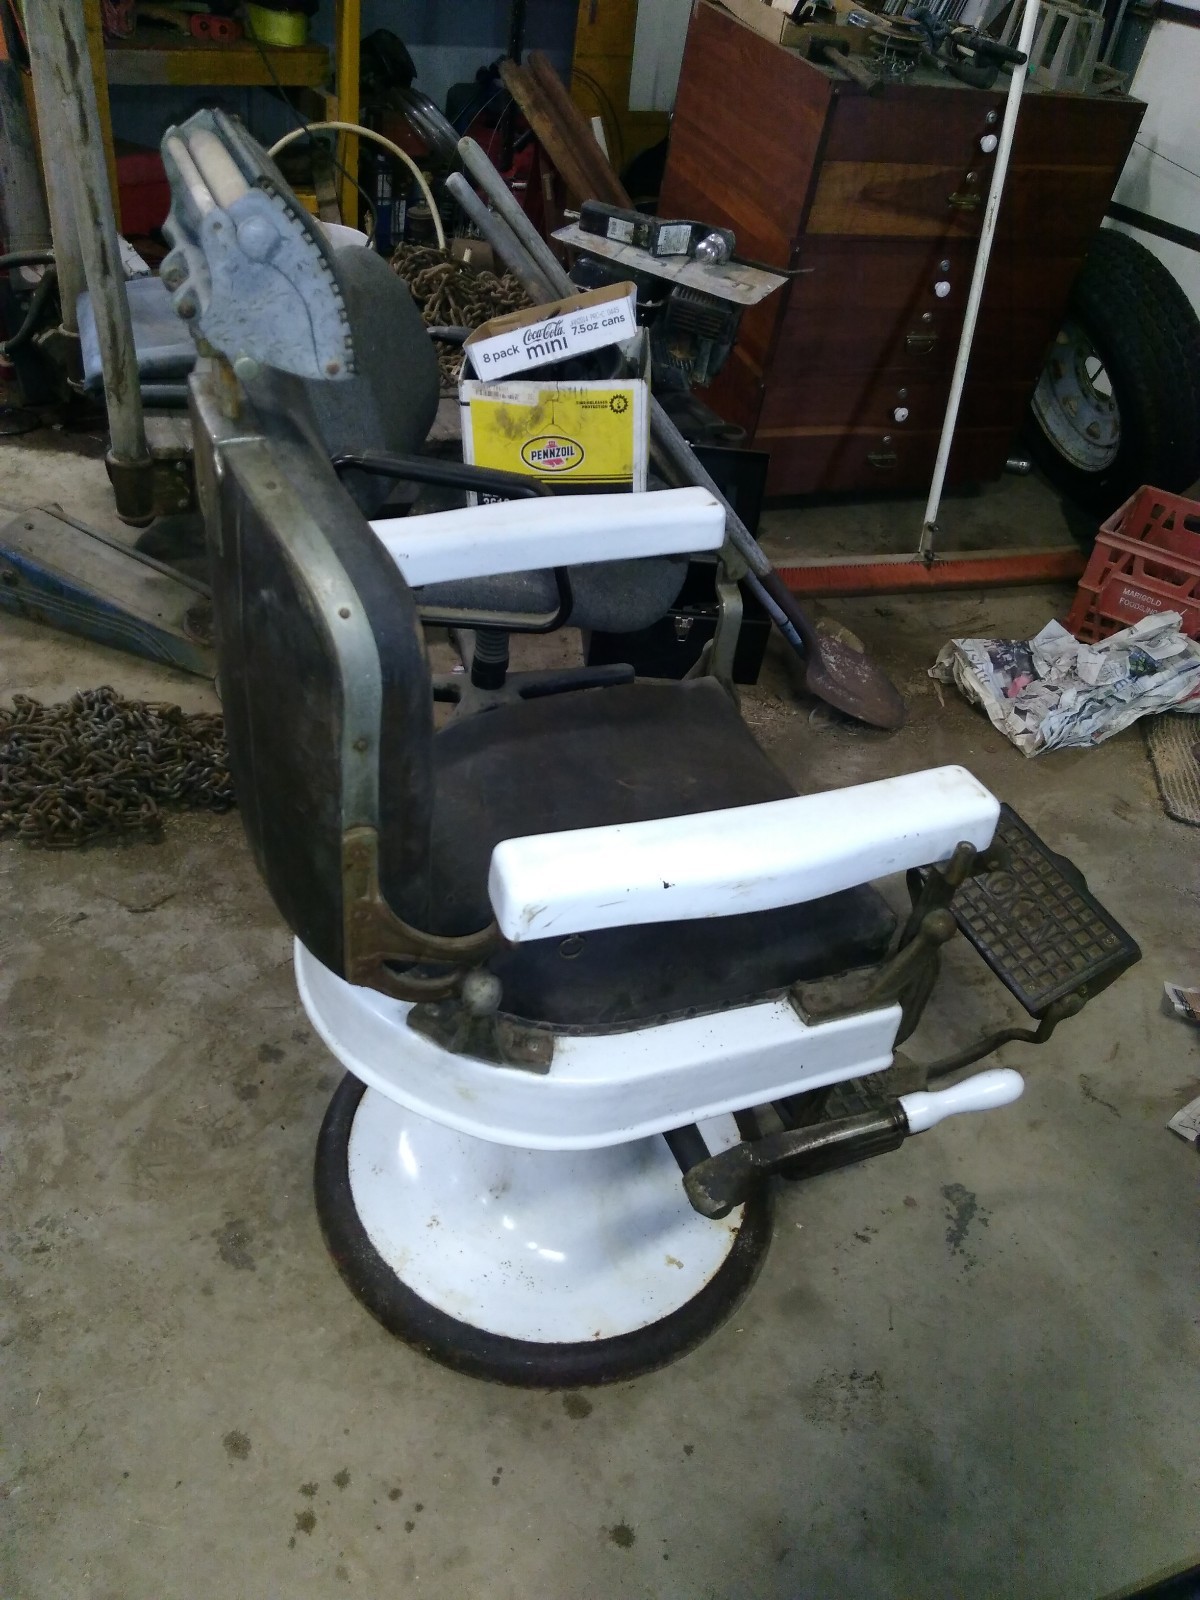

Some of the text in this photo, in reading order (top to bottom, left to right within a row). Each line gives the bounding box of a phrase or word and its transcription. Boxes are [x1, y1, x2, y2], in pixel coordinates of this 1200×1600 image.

[601, 314, 626, 327] cans
[523, 319, 564, 346] Coca-Cola
[483, 345, 520, 363] 8 pack
[526, 336, 569, 360] mini
[531, 446, 575, 461] PENNZOIL
[1122, 588, 1162, 607] MARIGOLD
